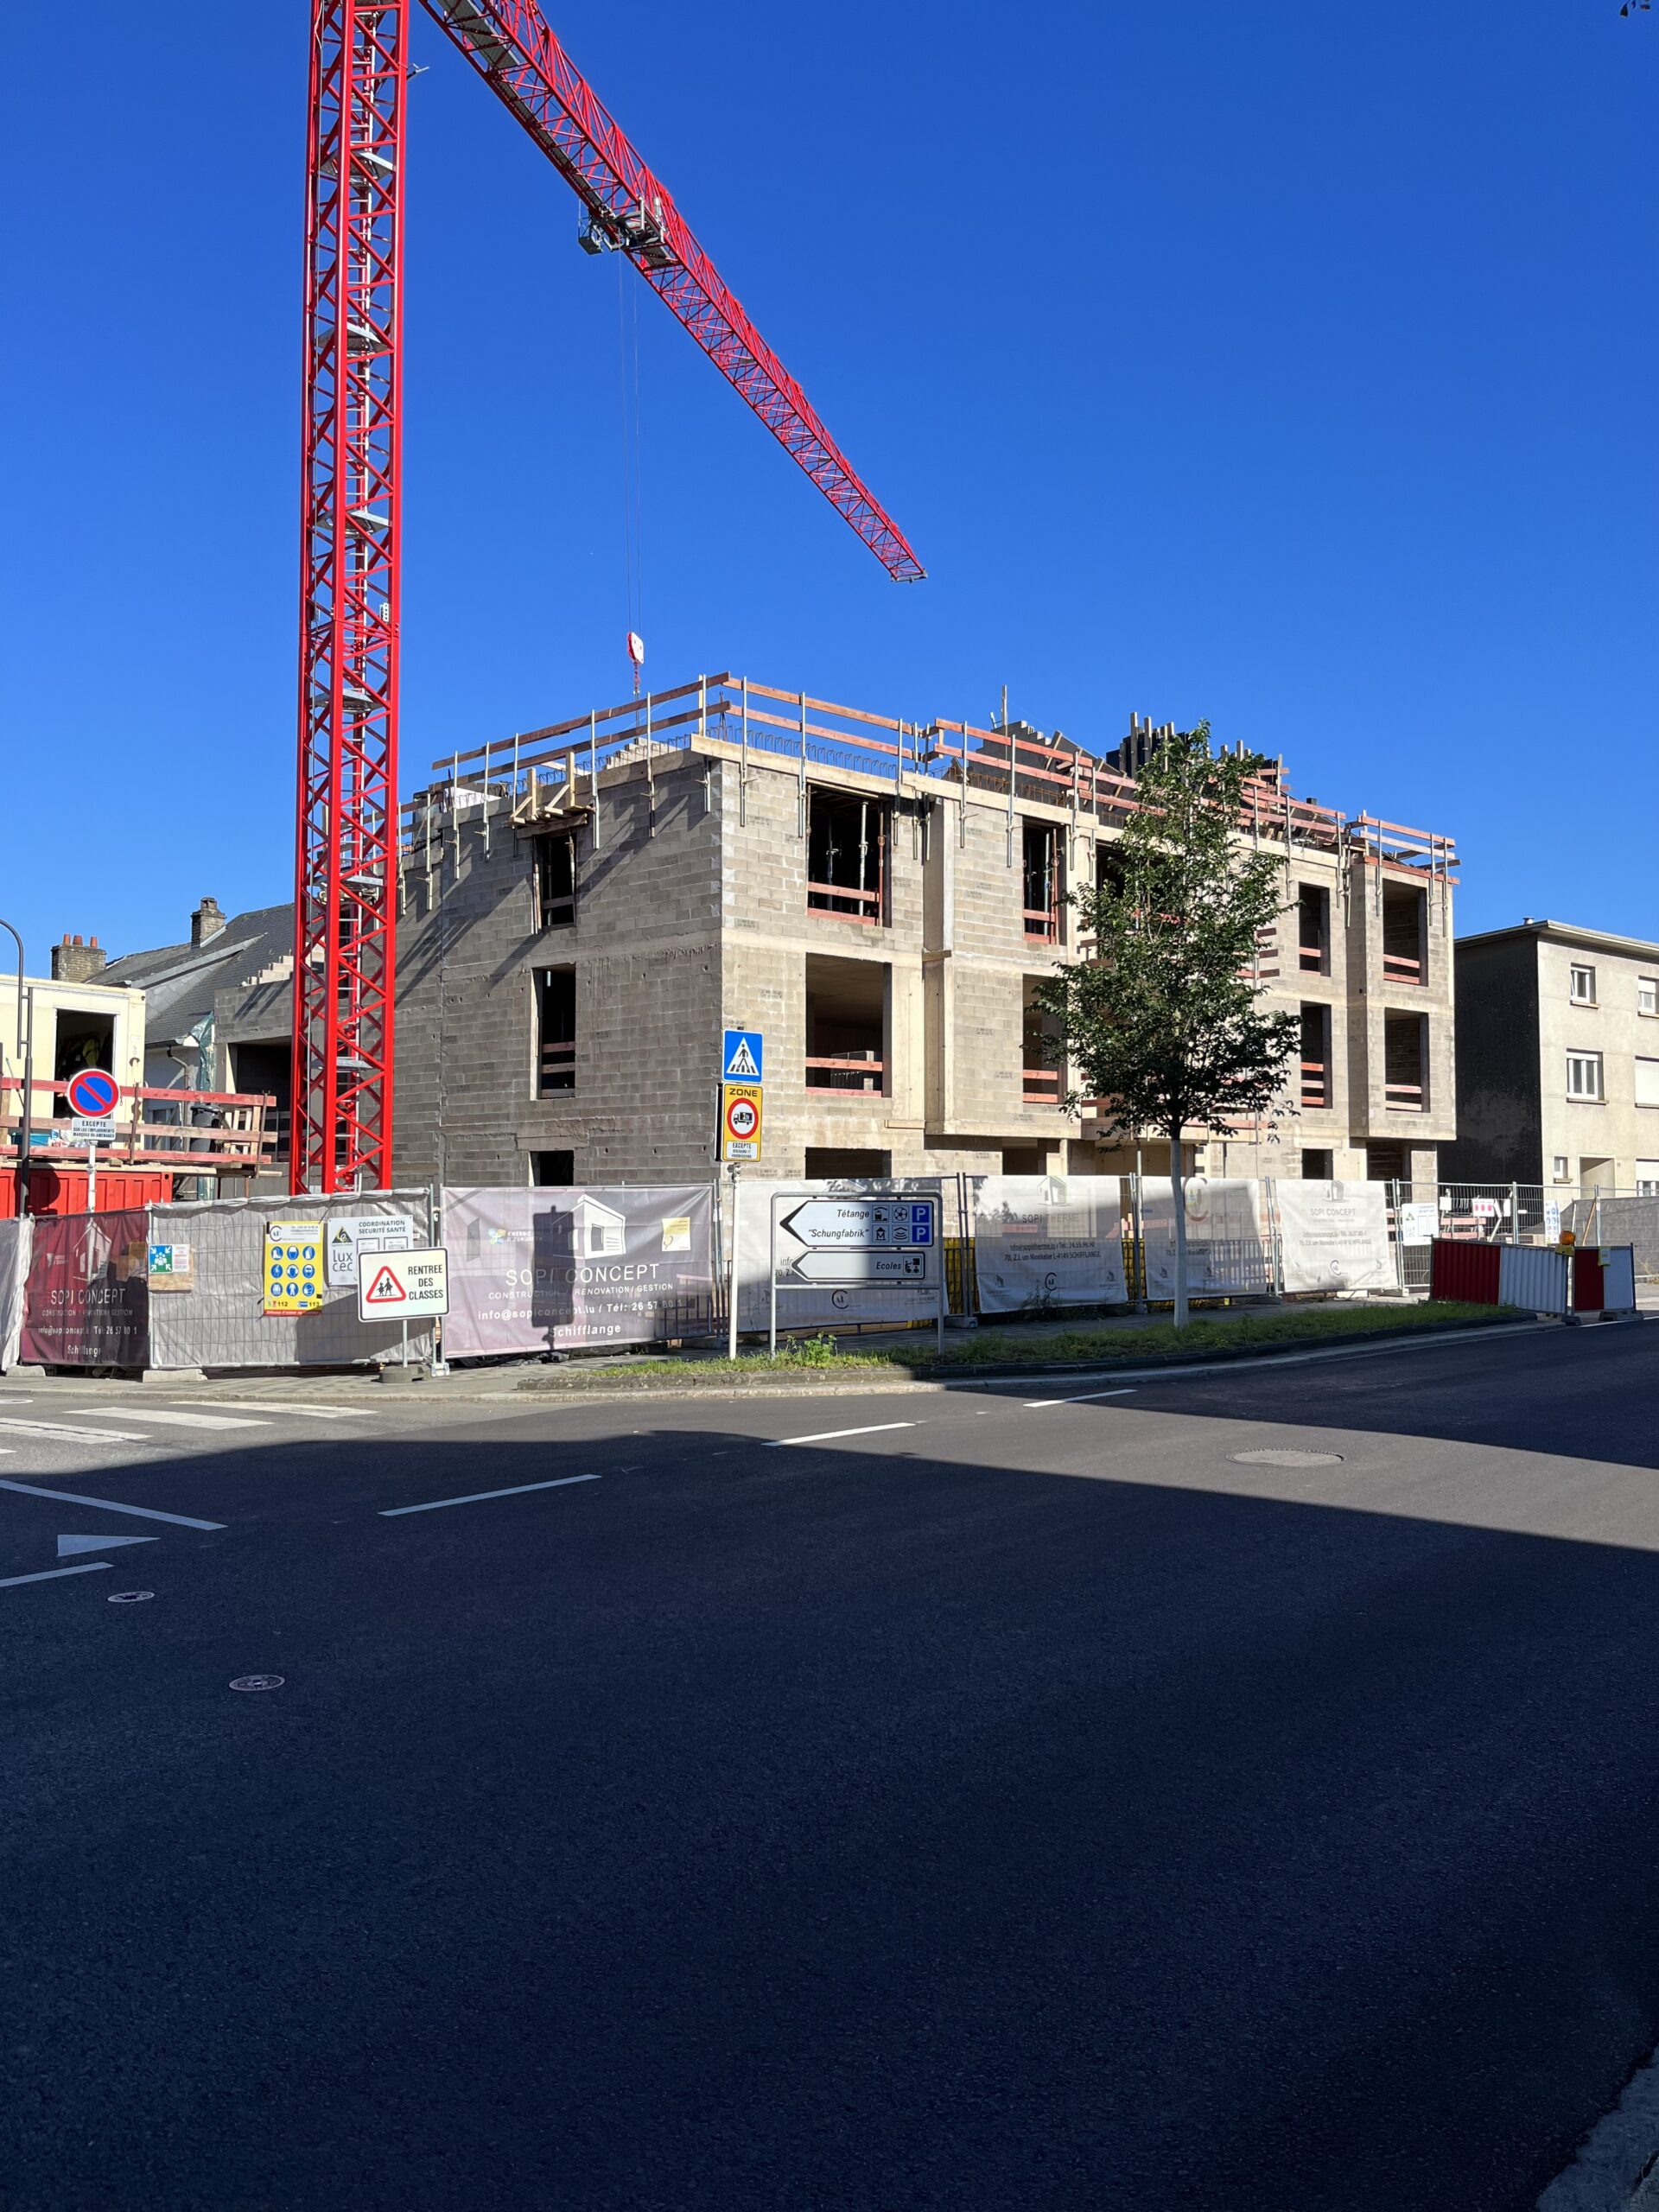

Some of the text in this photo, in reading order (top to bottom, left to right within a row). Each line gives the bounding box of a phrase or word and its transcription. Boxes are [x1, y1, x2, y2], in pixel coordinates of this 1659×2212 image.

[729, 1088, 758, 1096] ZONE
[837, 1209, 870, 1218] Tétange
[1022, 1214, 1042, 1223] SOPI
[333, 1249, 353, 1262] lux
[1069, 1250, 1101, 1259] SCHIFFLANGE
[408, 1264, 442, 1275] RENTREE
[876, 1261, 902, 1270] Ecoles
[505, 1263, 659, 1286] SOPI CONCEPT
[418, 1278, 434, 1287] DES
[575, 1286, 630, 1295] RENOVATION
[637, 1283, 673, 1293] GESTION
[50, 1288, 125, 1305] SOPI CONCEPT
[409, 1290, 443, 1300] CLASSES
[632, 1302, 644, 1311] 26
[647, 1300, 658, 1310] 57
[106, 1325, 113, 1334] 26
[549, 1325, 621, 1338] Schifflange
